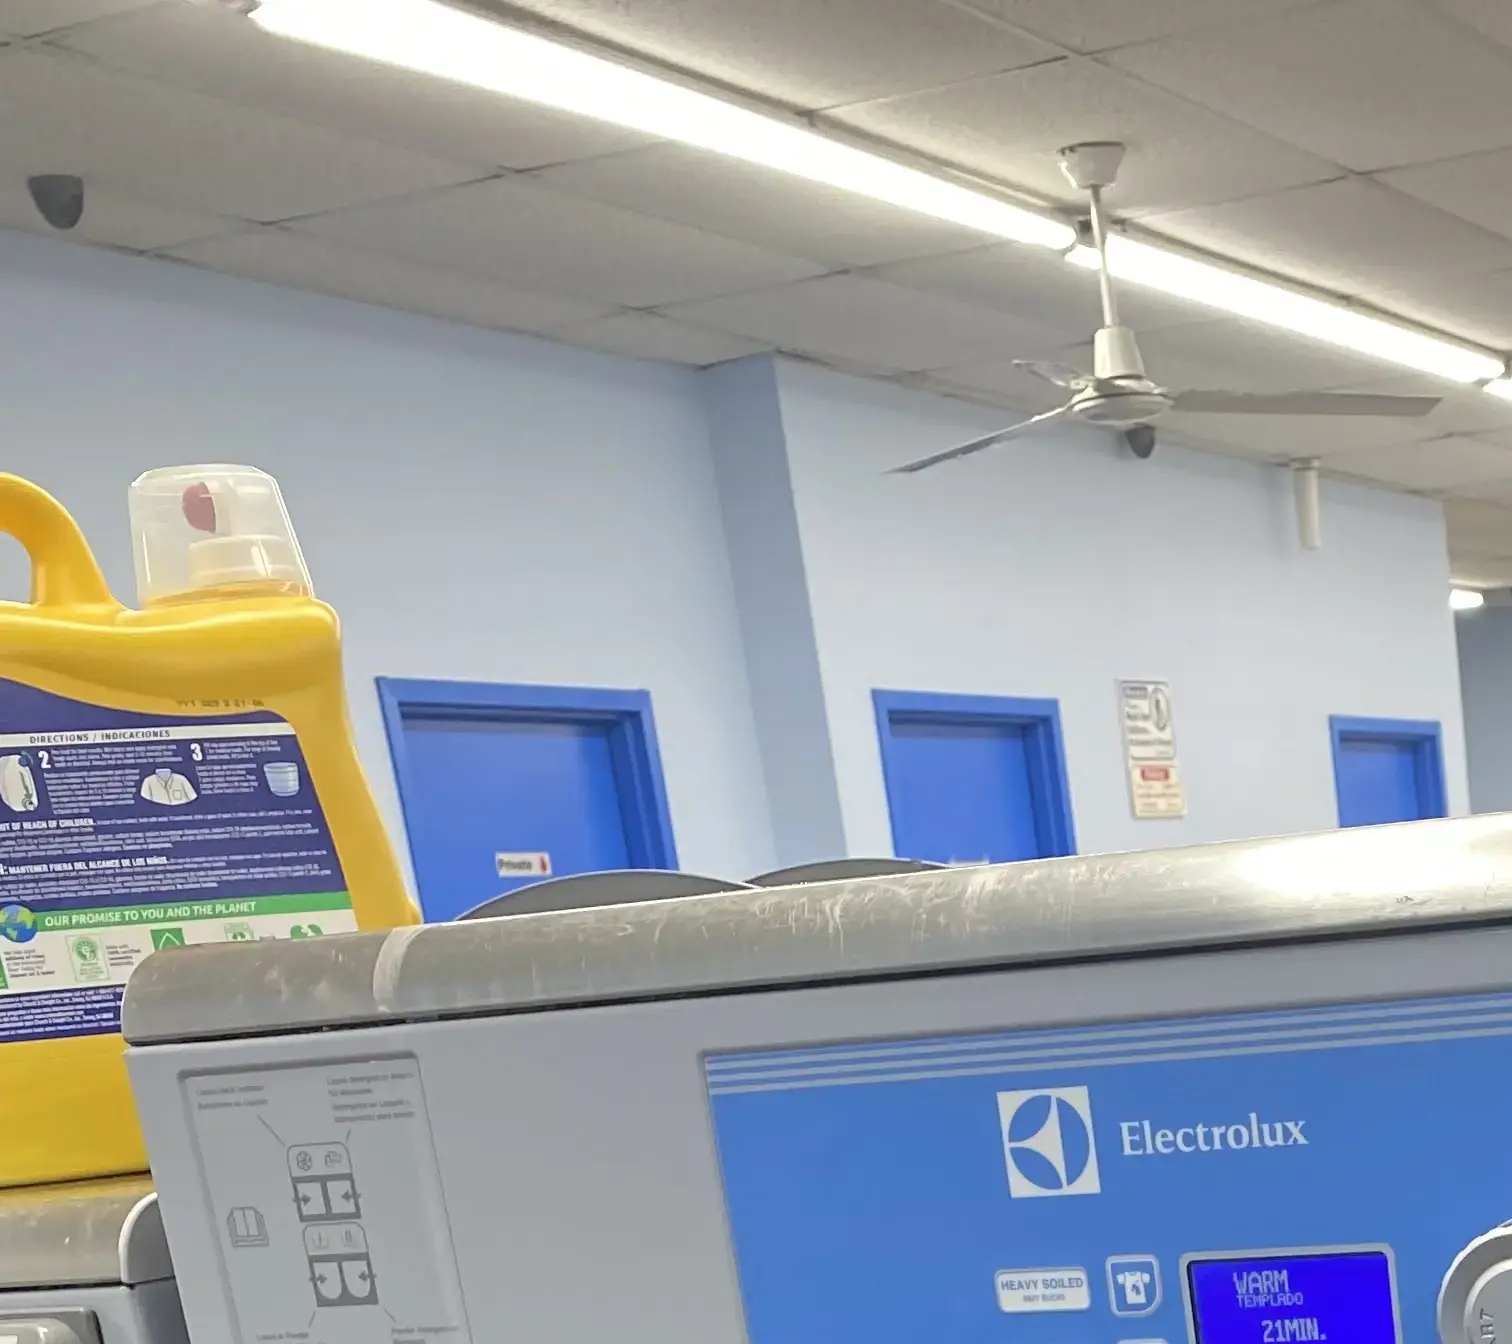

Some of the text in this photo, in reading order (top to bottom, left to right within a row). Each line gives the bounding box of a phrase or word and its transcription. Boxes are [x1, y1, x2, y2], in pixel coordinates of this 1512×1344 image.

[29, 733, 89, 744] DIRECTIONS
[101, 729, 171, 741] INDICACIONES
[38, 750, 52, 768] 2
[190, 743, 203, 761] 3
[45, 902, 257, 928] OUR PROMISE TO YOU AND THE PLANET
[1119, 1112, 1310, 1156] Electrolux
[1001, 1277, 1083, 1291] HEAVY SOILED
[1233, 1269, 1289, 1294] WARM
[1236, 1292, 1303, 1308] TEMPLADO
[1261, 1317, 1327, 1343] 21MIN.
